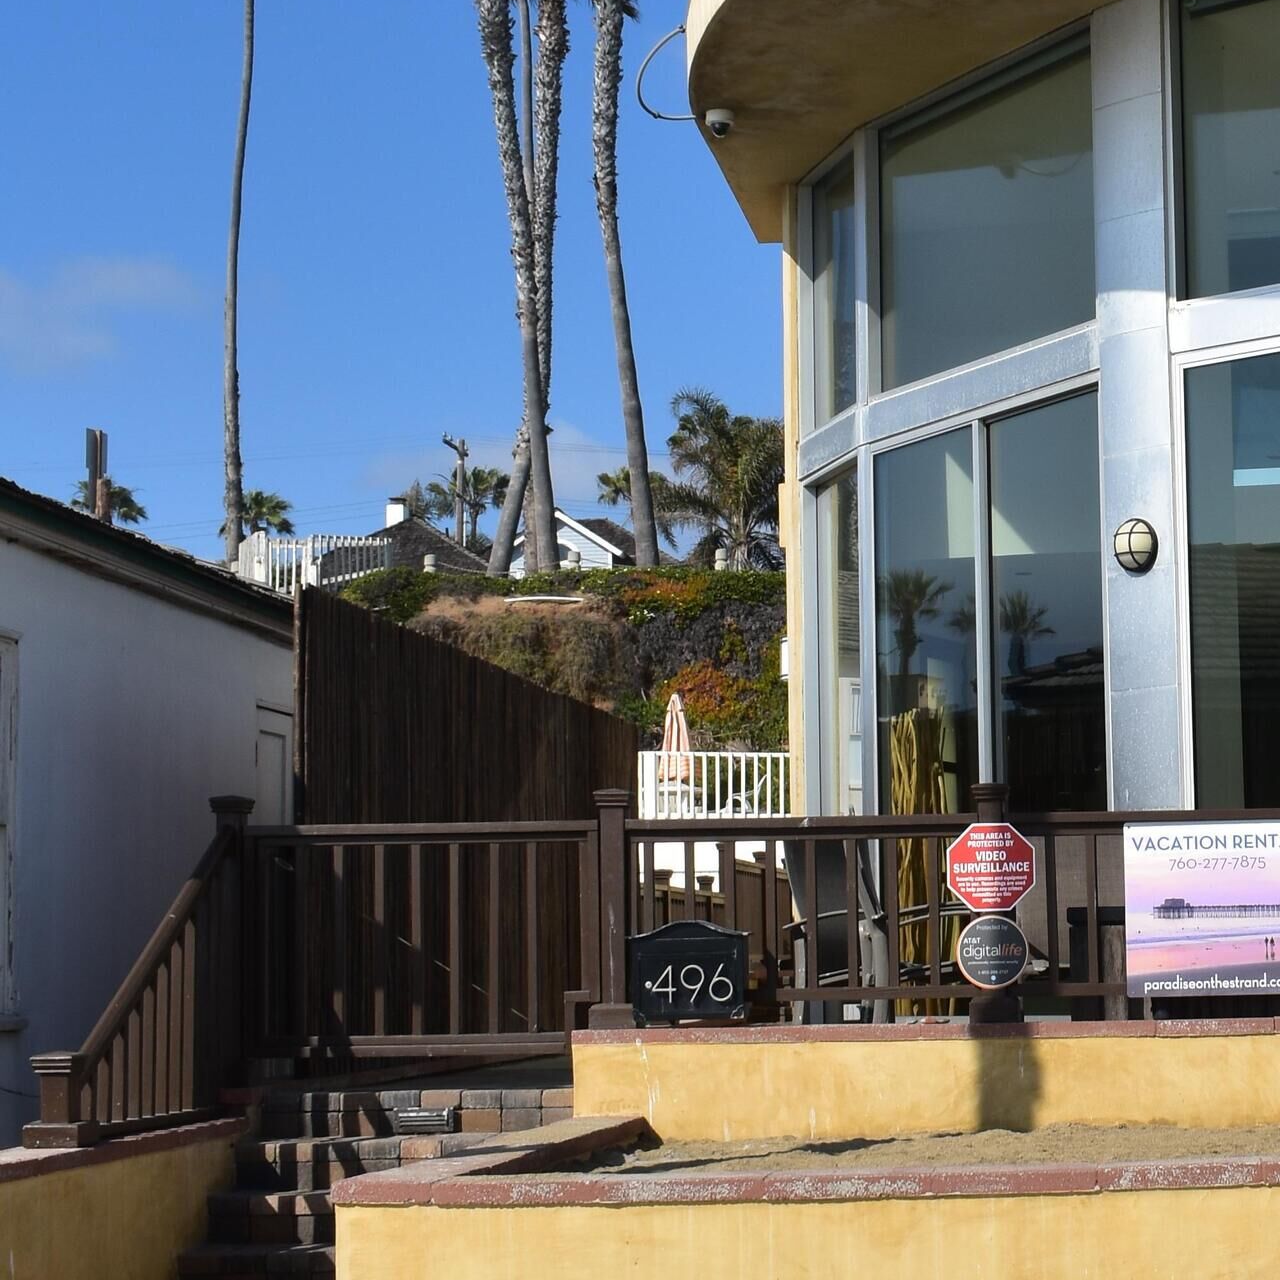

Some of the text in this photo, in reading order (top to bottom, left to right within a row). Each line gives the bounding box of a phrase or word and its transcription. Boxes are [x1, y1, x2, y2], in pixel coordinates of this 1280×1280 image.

[985, 832, 1003, 840] AREA
[1004, 832, 1011, 840] IS
[967, 840, 1004, 848] PROTECTED
[1132, 834, 1227, 852] VACATION
[975, 850, 1007, 861] VIDEO
[953, 861, 1030, 873] SURVEILLANCE
[1168, 855, 1267, 872] 760-277-7875
[651, 963, 733, 1004] 496
